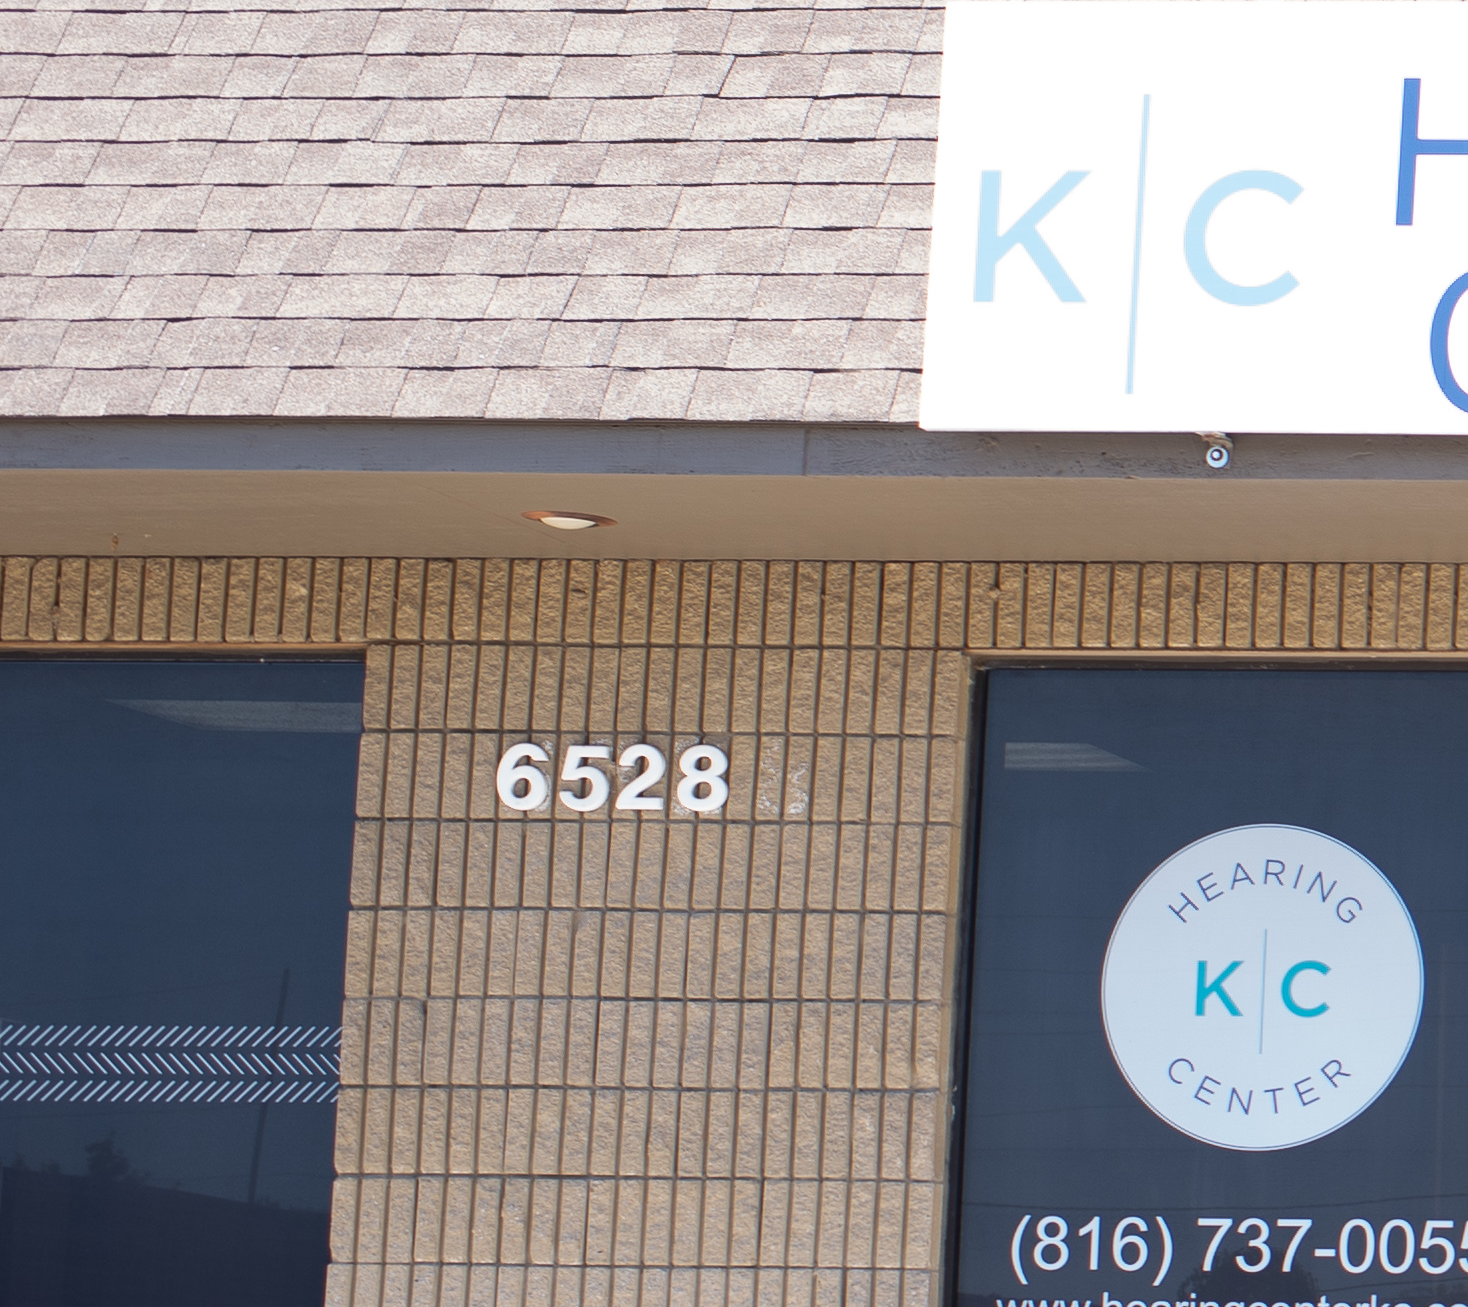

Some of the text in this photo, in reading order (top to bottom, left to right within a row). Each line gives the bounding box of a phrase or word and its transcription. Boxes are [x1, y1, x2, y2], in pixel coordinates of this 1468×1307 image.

[496, 742, 729, 812] 6528
[1167, 859, 1364, 923] HEARING
[1167, 1057, 1352, 1115] CENTER
[1010, 1214, 1174, 1286] (816)
